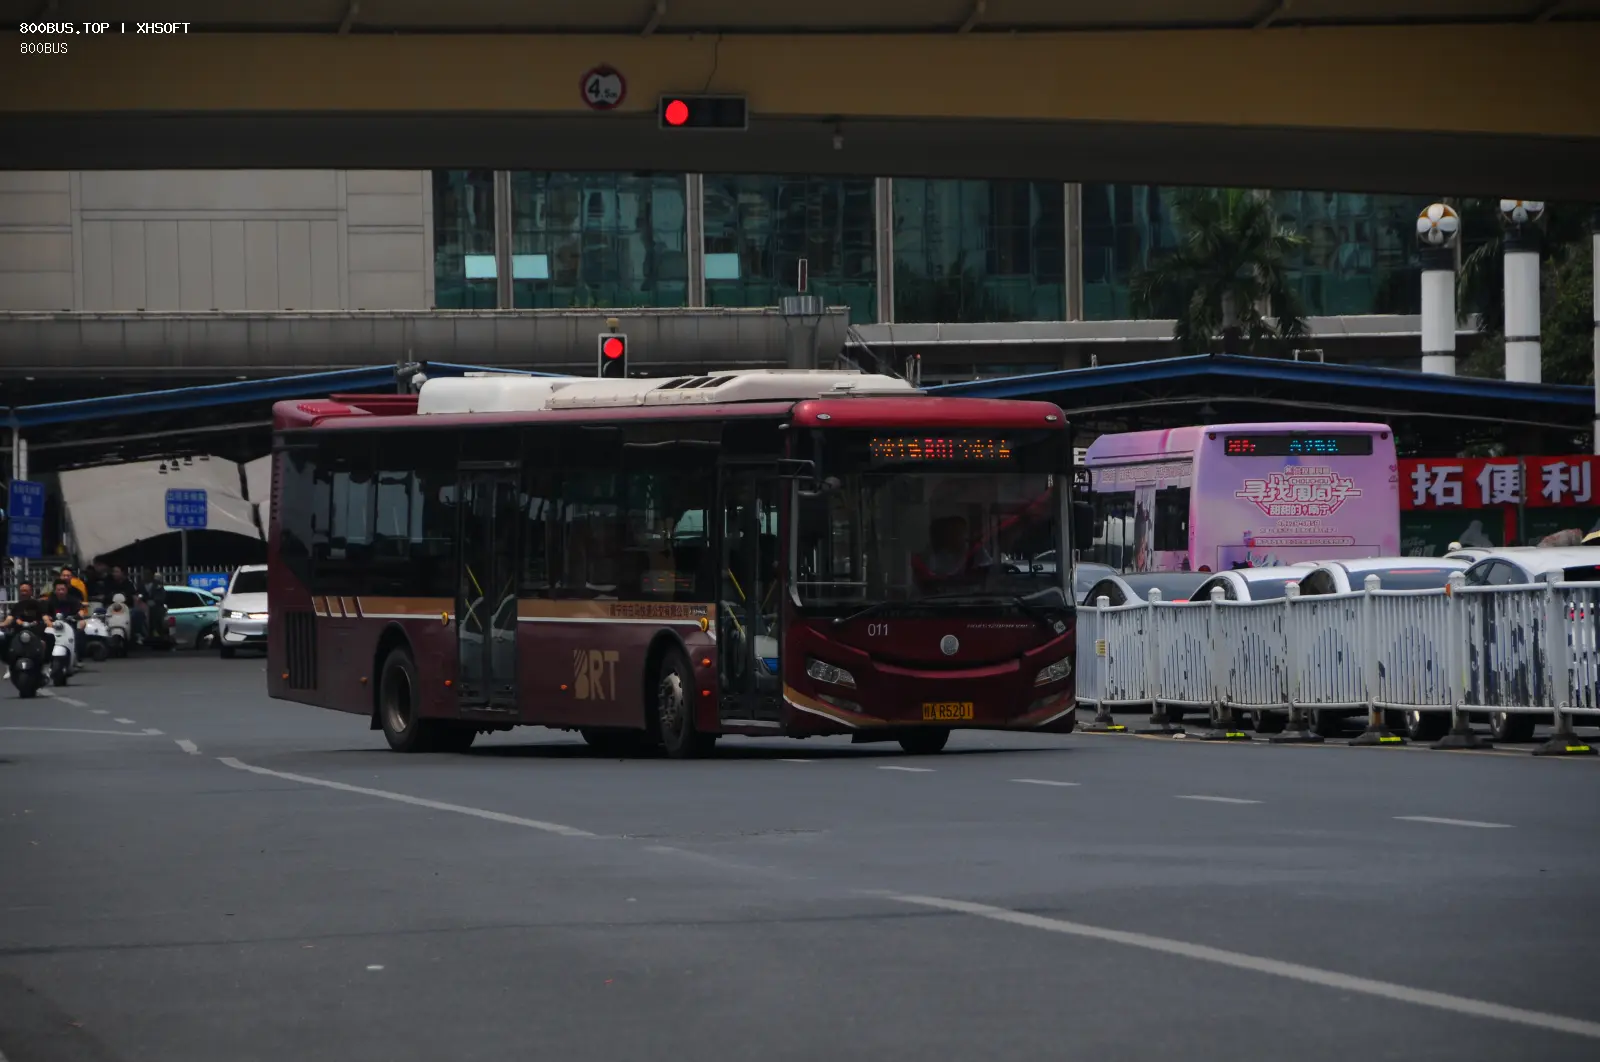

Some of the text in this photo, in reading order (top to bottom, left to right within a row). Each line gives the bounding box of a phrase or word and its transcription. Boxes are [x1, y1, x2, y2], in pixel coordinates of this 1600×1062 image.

[1411, 460, 1592, 506] 拓便利
[868, 623, 888, 637] 011
